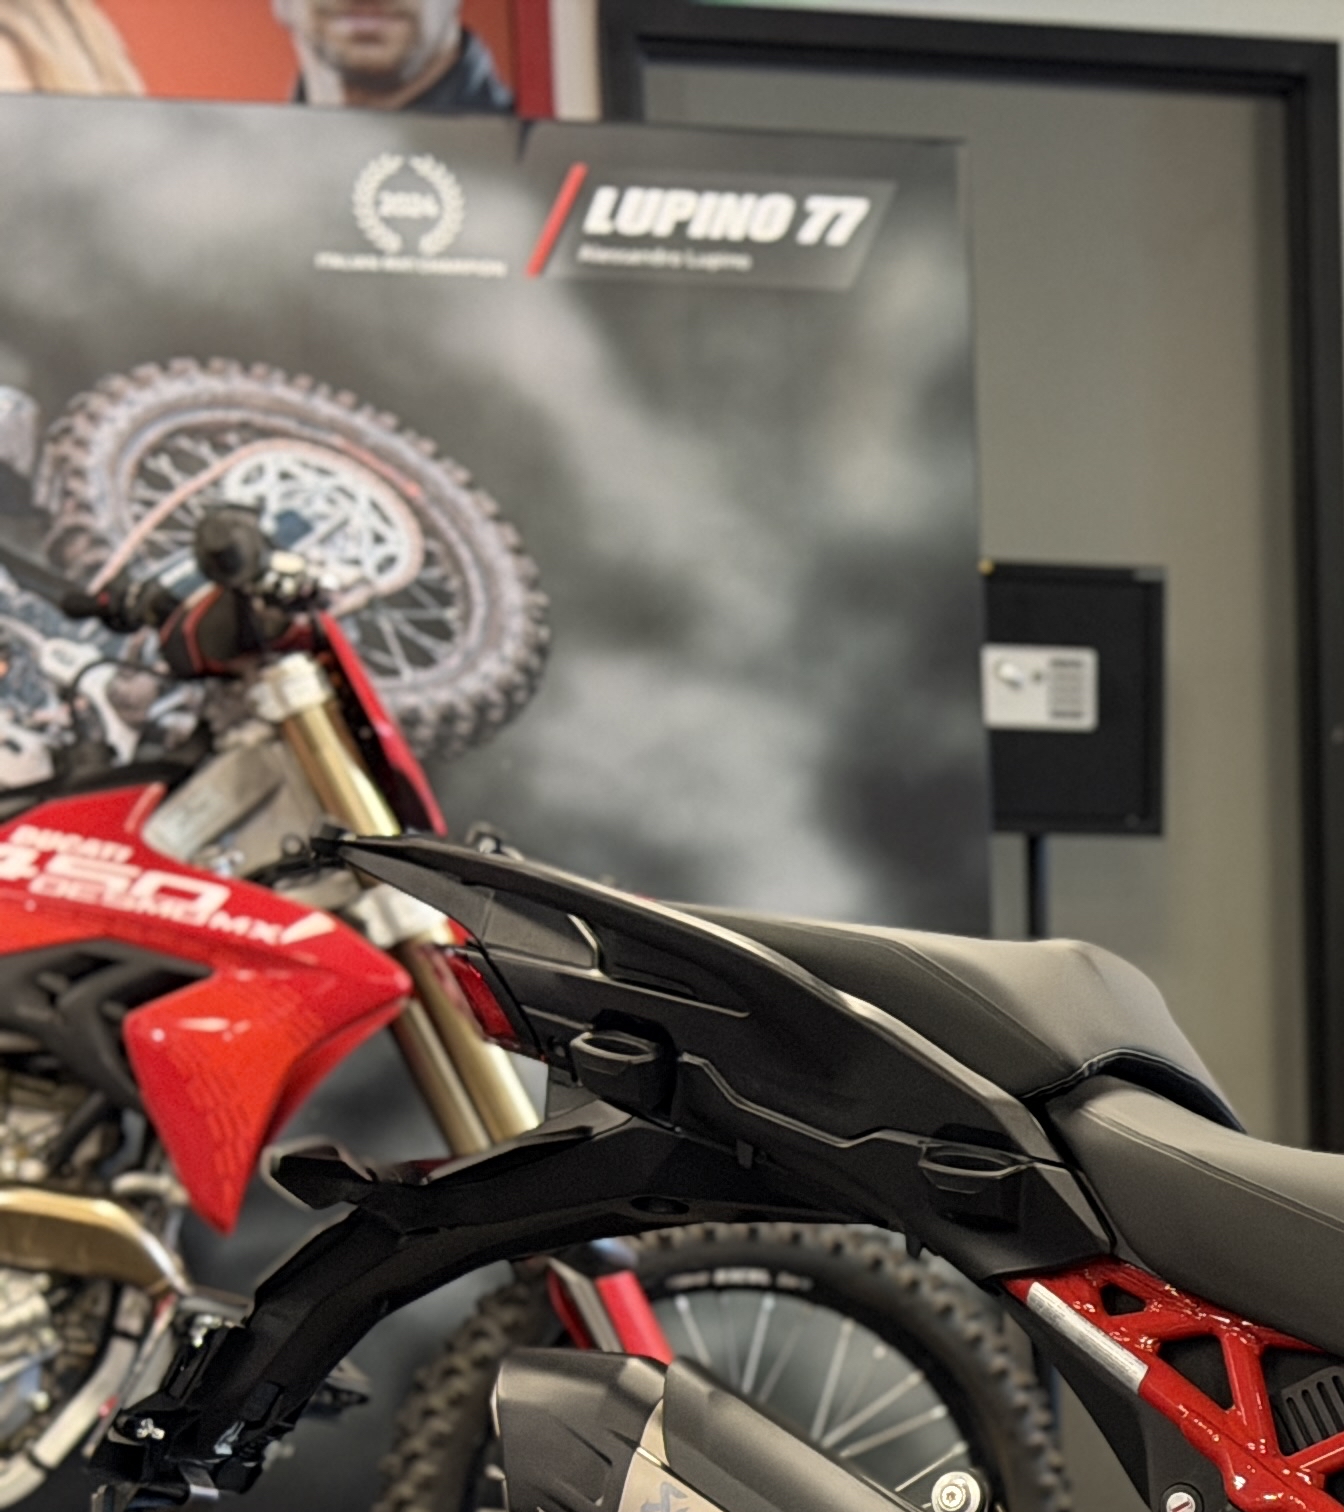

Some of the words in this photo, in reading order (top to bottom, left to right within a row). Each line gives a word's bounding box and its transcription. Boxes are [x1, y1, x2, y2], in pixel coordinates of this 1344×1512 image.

[582, 185, 797, 243] LUPINO
[795, 194, 871, 247] 77
[685, 247, 753, 272] Lupino
[8, 824, 134, 864] DUCATI
